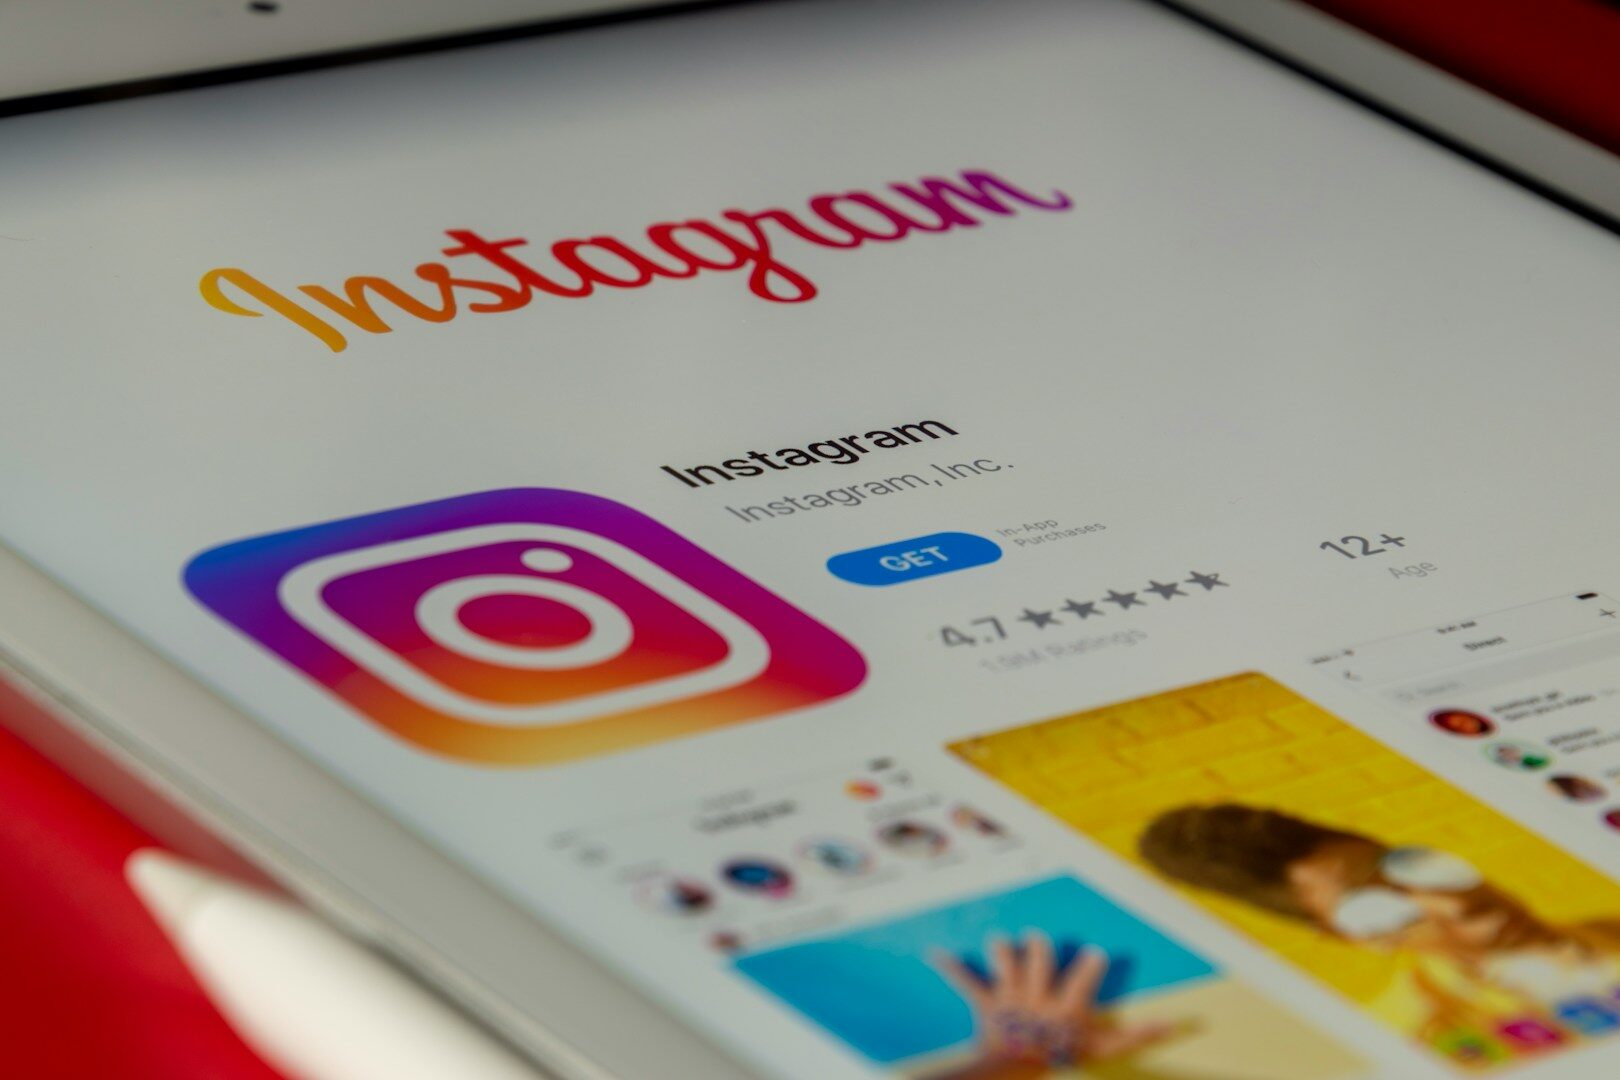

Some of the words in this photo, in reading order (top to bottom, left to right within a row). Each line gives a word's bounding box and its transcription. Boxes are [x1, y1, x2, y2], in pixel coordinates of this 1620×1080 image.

[198, 168, 1074, 354] Instagram
[660, 413, 959, 489] Instagram
[724, 469, 943, 524] Instagram,
[940, 456, 1015, 481] Inc.
[995, 517, 1058, 538] In-App
[1013, 523, 1107, 547] Purchases
[878, 545, 949, 573] GET
[1319, 533, 1405, 560] 12+
[1388, 560, 1438, 580] Age
[940, 615, 1008, 648] 4.7
